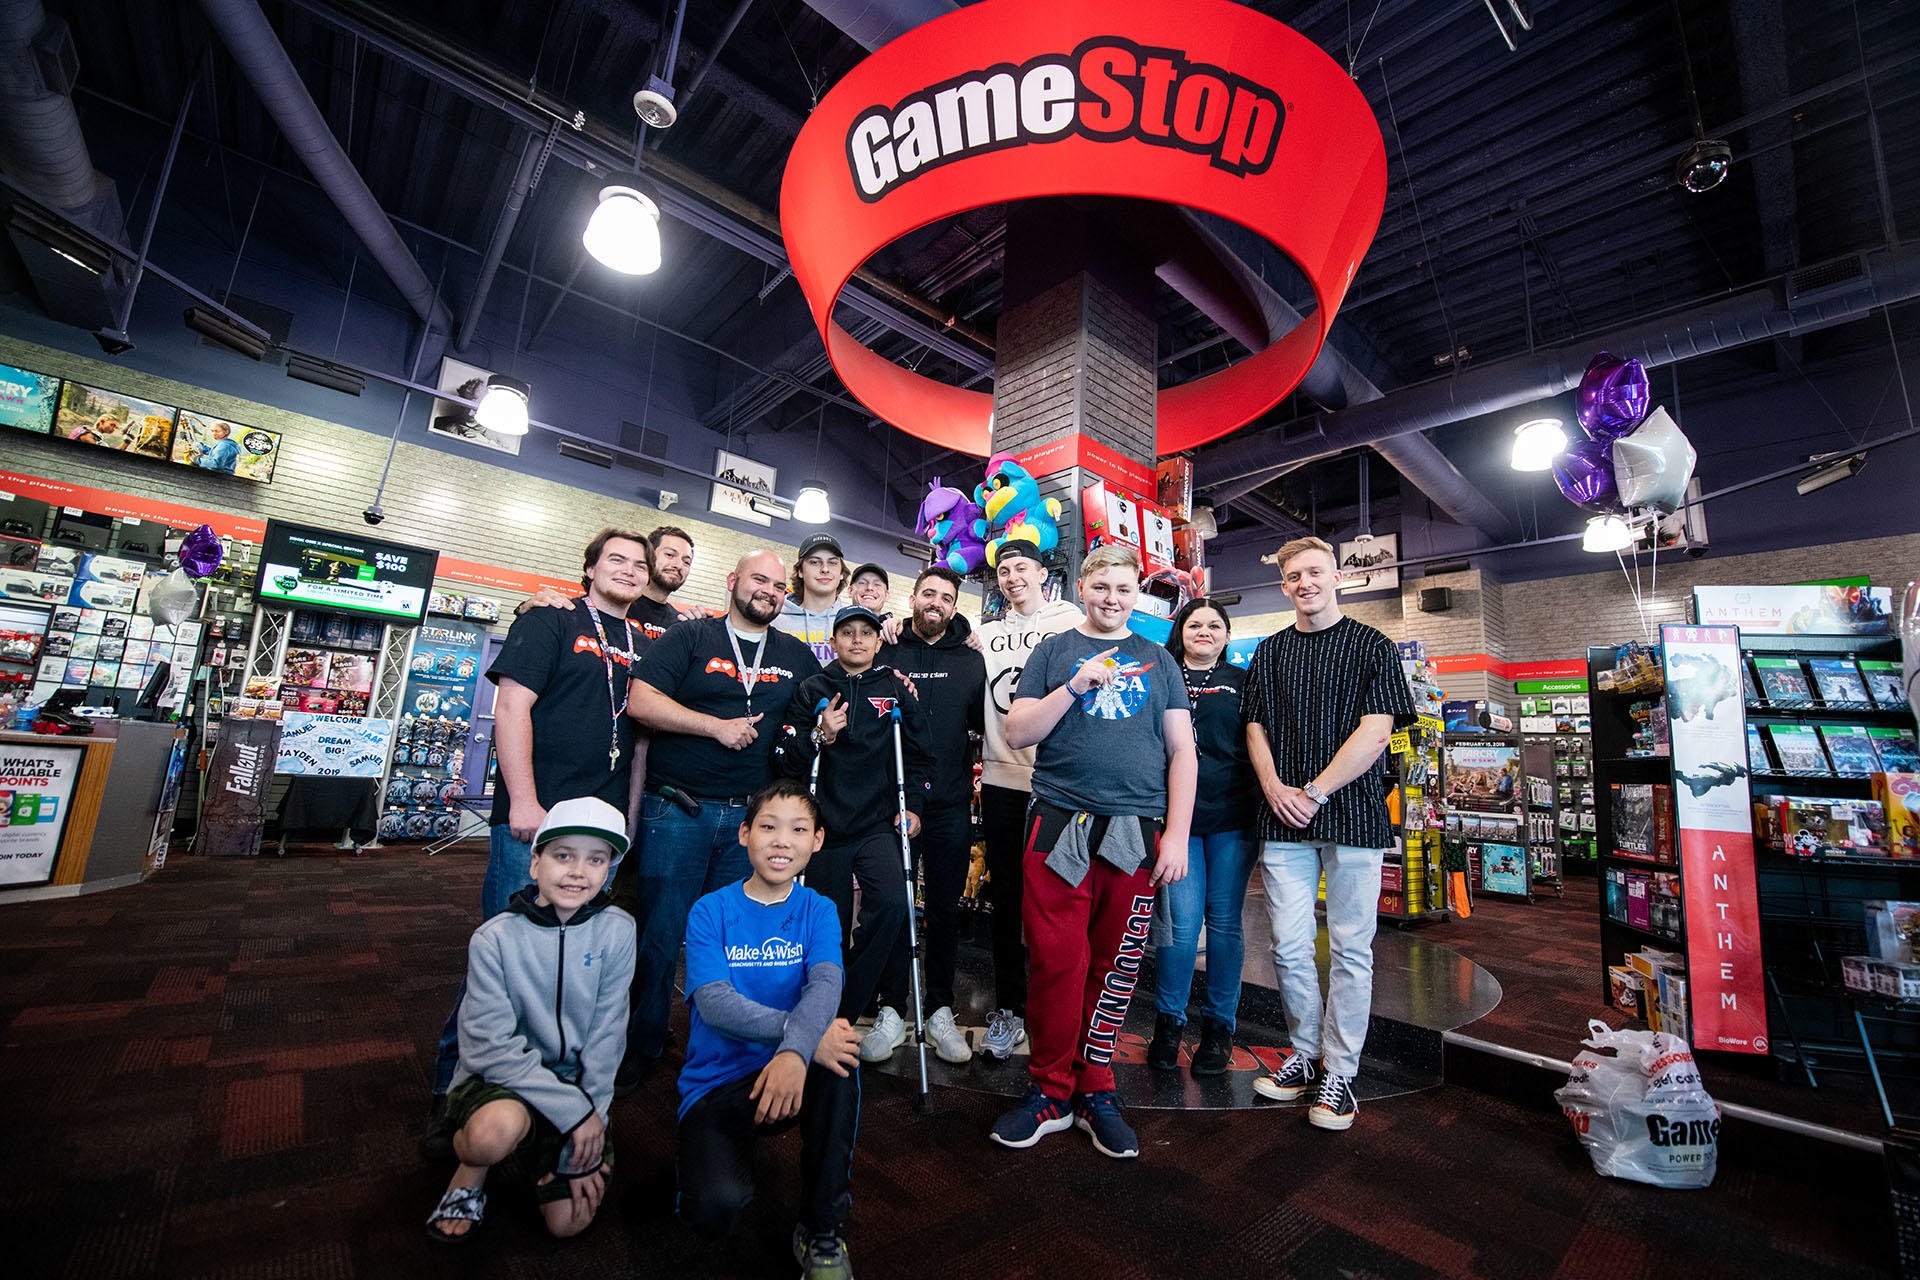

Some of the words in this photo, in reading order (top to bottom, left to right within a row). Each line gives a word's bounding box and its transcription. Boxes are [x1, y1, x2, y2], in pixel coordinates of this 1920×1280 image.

[851, 46, 1279, 195] GameStop
[1033, 445, 1065, 460] players
[1086, 451, 1107, 464] power
[1117, 465, 1128, 474] the
[104, 506, 137, 516] power
[374, 552, 409, 565] SAVE
[375, 561, 407, 573] $100
[333, 587, 365, 597] LIMITED
[1704, 607, 1784, 617] ANTHEM
[421, 626, 477, 642] STARLINK
[1542, 683, 1582, 691] Accessories
[315, 714, 363, 725] WELCOME
[280, 722, 317, 739] SAMUEL
[317, 736, 352, 745] DREAM
[1391, 737, 1409, 746] 50%
[324, 746, 346, 755] BIG!
[3, 758, 55, 768] WHAT'S
[277, 749, 318, 767] HAYDEN
[349, 753, 384, 769] SAMUEL
[0, 767, 62, 778] VAILABLE
[225, 743, 260, 796] Fallout
[317, 767, 341, 776] 2019
[0, 777, 49, 787] POINTS
[15, 852, 43, 860] TODAY
[1711, 844, 1738, 1012] ANTHEM
[1718, 1036, 1748, 1046] BioWare
[1653, 1073, 1673, 1088] get
[1669, 1154, 1702, 1163] POWER
